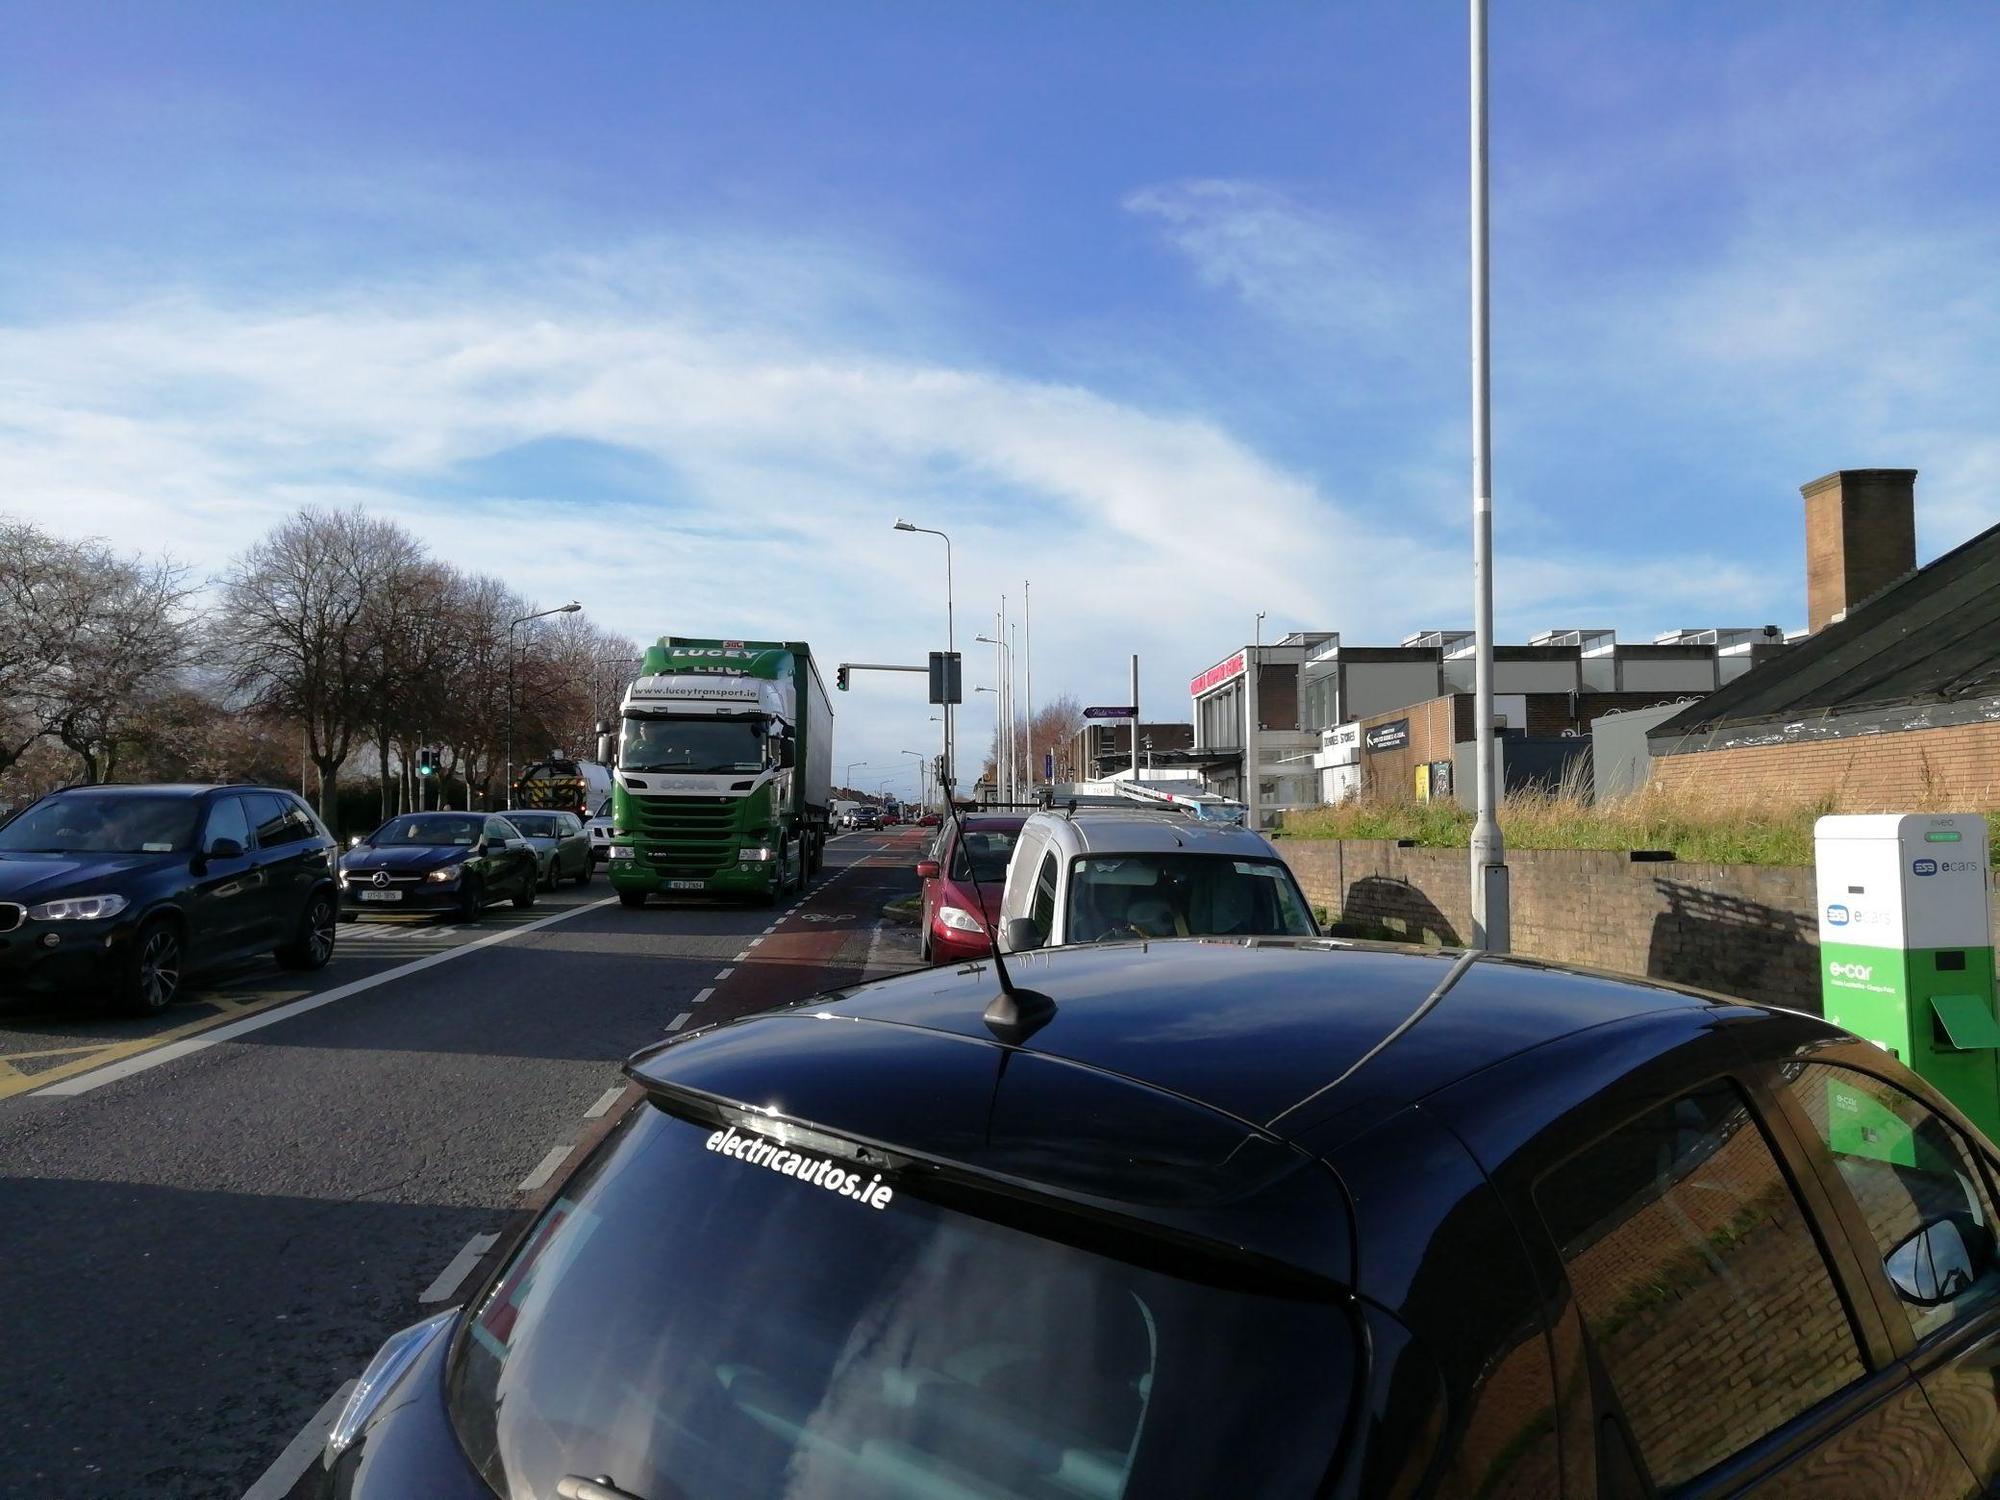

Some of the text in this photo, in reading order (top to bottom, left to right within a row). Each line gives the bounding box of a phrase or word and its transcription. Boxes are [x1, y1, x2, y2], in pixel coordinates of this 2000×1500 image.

[672, 649, 759, 659] LUCEY
[634, 687, 757, 697] www.luceytransport.ie
[1941, 861, 1977, 872] ecars
[705, 1126, 893, 1210] electricautos.ie
